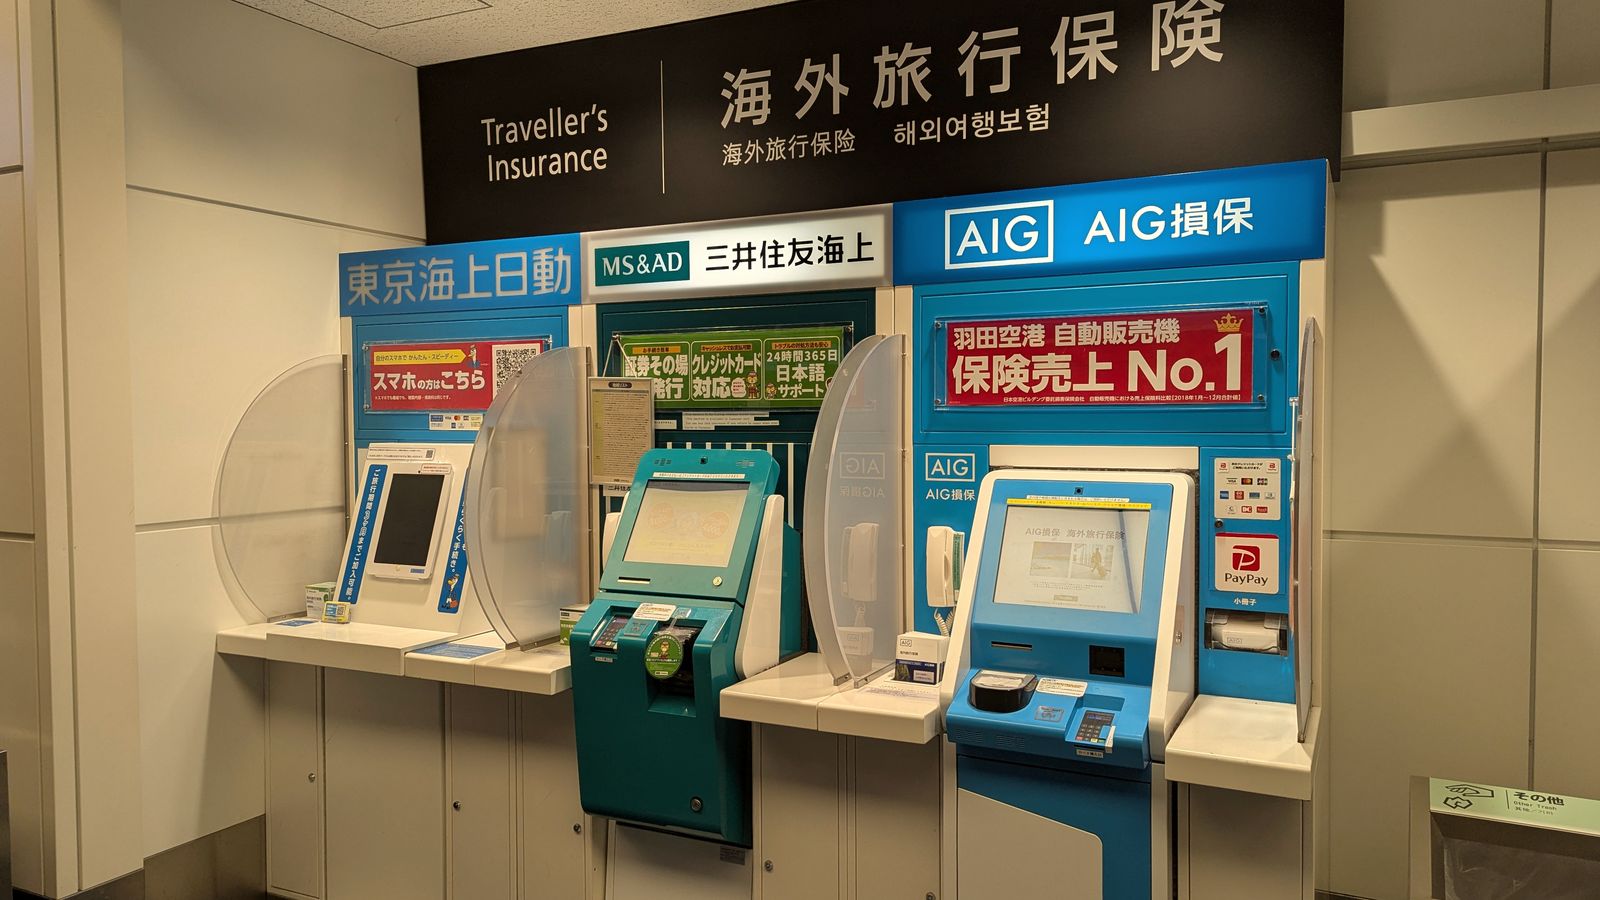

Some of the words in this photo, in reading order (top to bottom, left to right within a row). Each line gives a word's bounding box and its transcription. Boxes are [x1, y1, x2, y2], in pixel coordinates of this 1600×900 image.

[721, 0, 1224, 129] 海外旅行保険
[481, 104, 608, 146] Traveller's
[894, 103, 1051, 146] 해외여행보험
[722, 128, 856, 166] 海外旅行保险
[488, 148, 608, 182] Insurance
[1084, 197, 1254, 246] AIG損保
[956, 214, 1040, 257] AIG
[705, 231, 875, 272] 三井住友海上
[347, 247, 572, 306] 東京海上日動
[602, 252, 683, 277] MS&AD
[953, 323, 1046, 350] 羽田空港
[1054, 318, 1181, 348] 自動販売機
[692, 352, 762, 375] クレジットカード
[766, 349, 838, 362] 24時間365日
[952, 350, 1115, 395] 保険売上
[1127, 333, 1242, 393] No.1
[373, 370, 486, 391] スマホの方はこちら
[776, 363, 826, 382] 日本語
[693, 377, 731, 399] 対応
[777, 382, 825, 398] サポート
[930, 458, 969, 476] AIG
[926, 488, 976, 501] AIG損保
[1025, 527, 1061, 537] AIG損保
[1224, 572, 1269, 586] PayPay
[1233, 598, 1257, 606] 小冊子
[1513, 791, 1565, 806] その他
